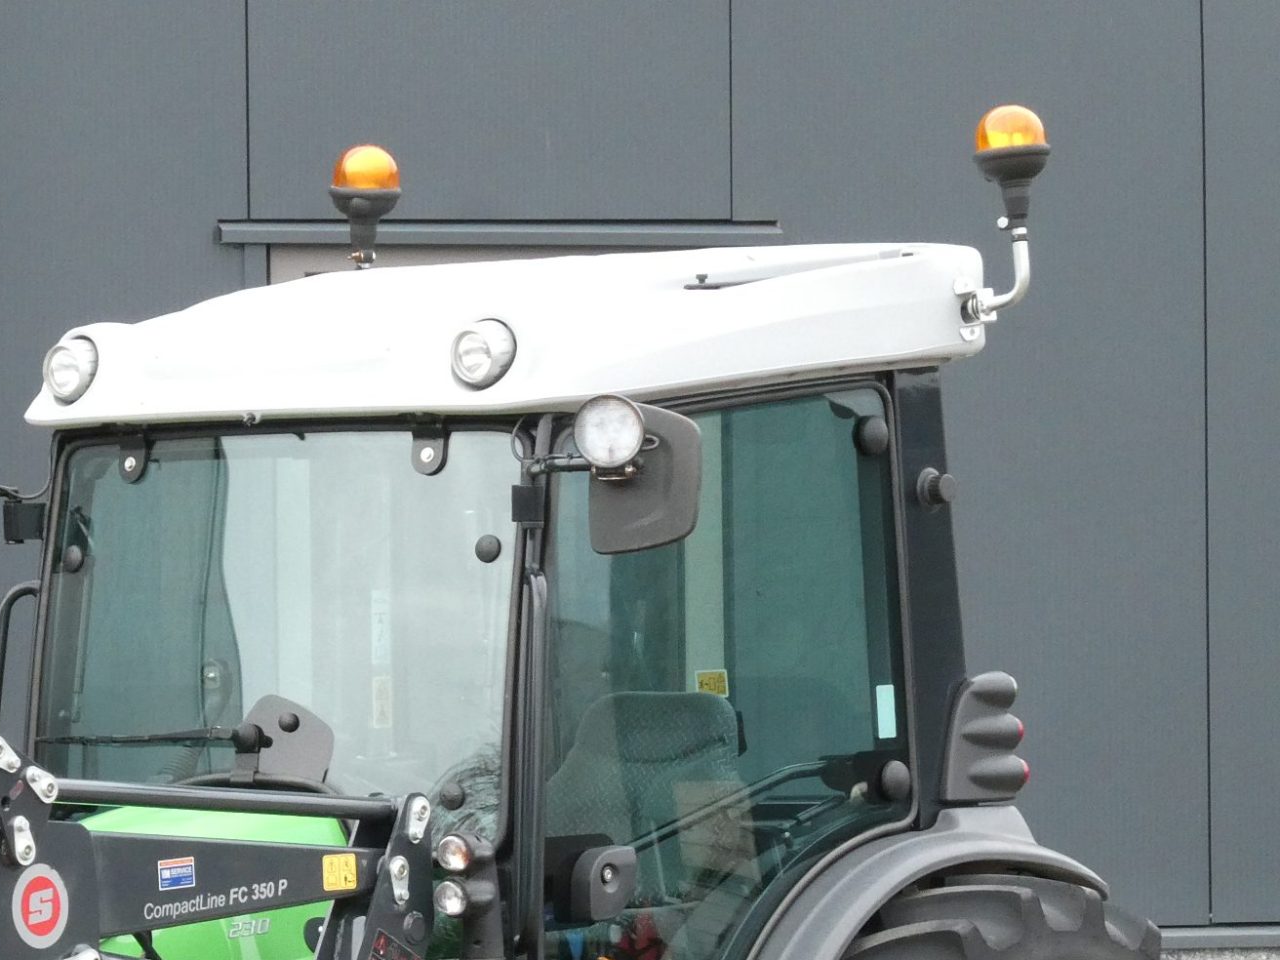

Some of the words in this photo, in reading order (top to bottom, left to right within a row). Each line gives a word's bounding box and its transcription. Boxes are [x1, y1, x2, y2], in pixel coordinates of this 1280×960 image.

[28, 887, 54, 926] S
[144, 892, 226, 920] CompactLine
[229, 886, 249, 905] FC
[251, 881, 275, 900] 350
[278, 879, 288, 896] P
